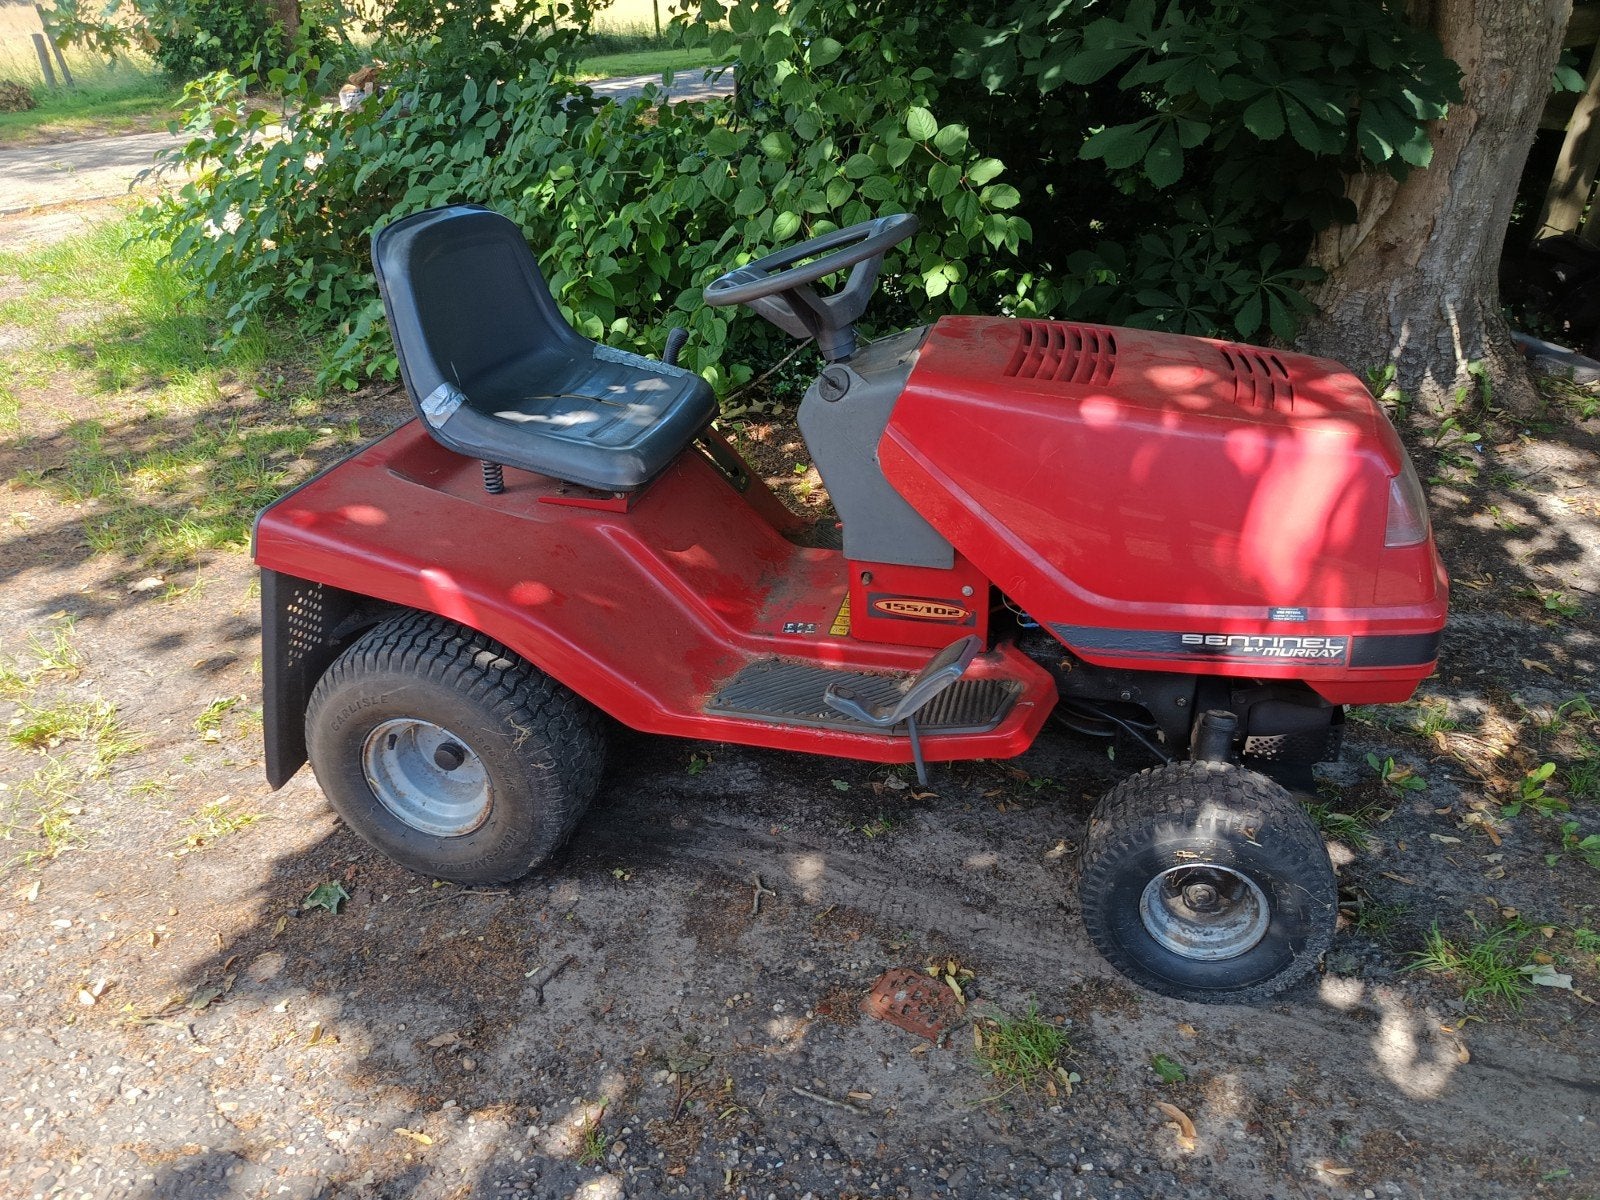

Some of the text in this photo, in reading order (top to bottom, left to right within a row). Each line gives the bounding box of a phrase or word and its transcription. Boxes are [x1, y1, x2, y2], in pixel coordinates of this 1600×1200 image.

[885, 602, 960, 617] 155/102
[1182, 635, 1343, 649] SENTINEL
[1263, 648, 1342, 658] MURRAY
[331, 694, 389, 732] CARLISLE
